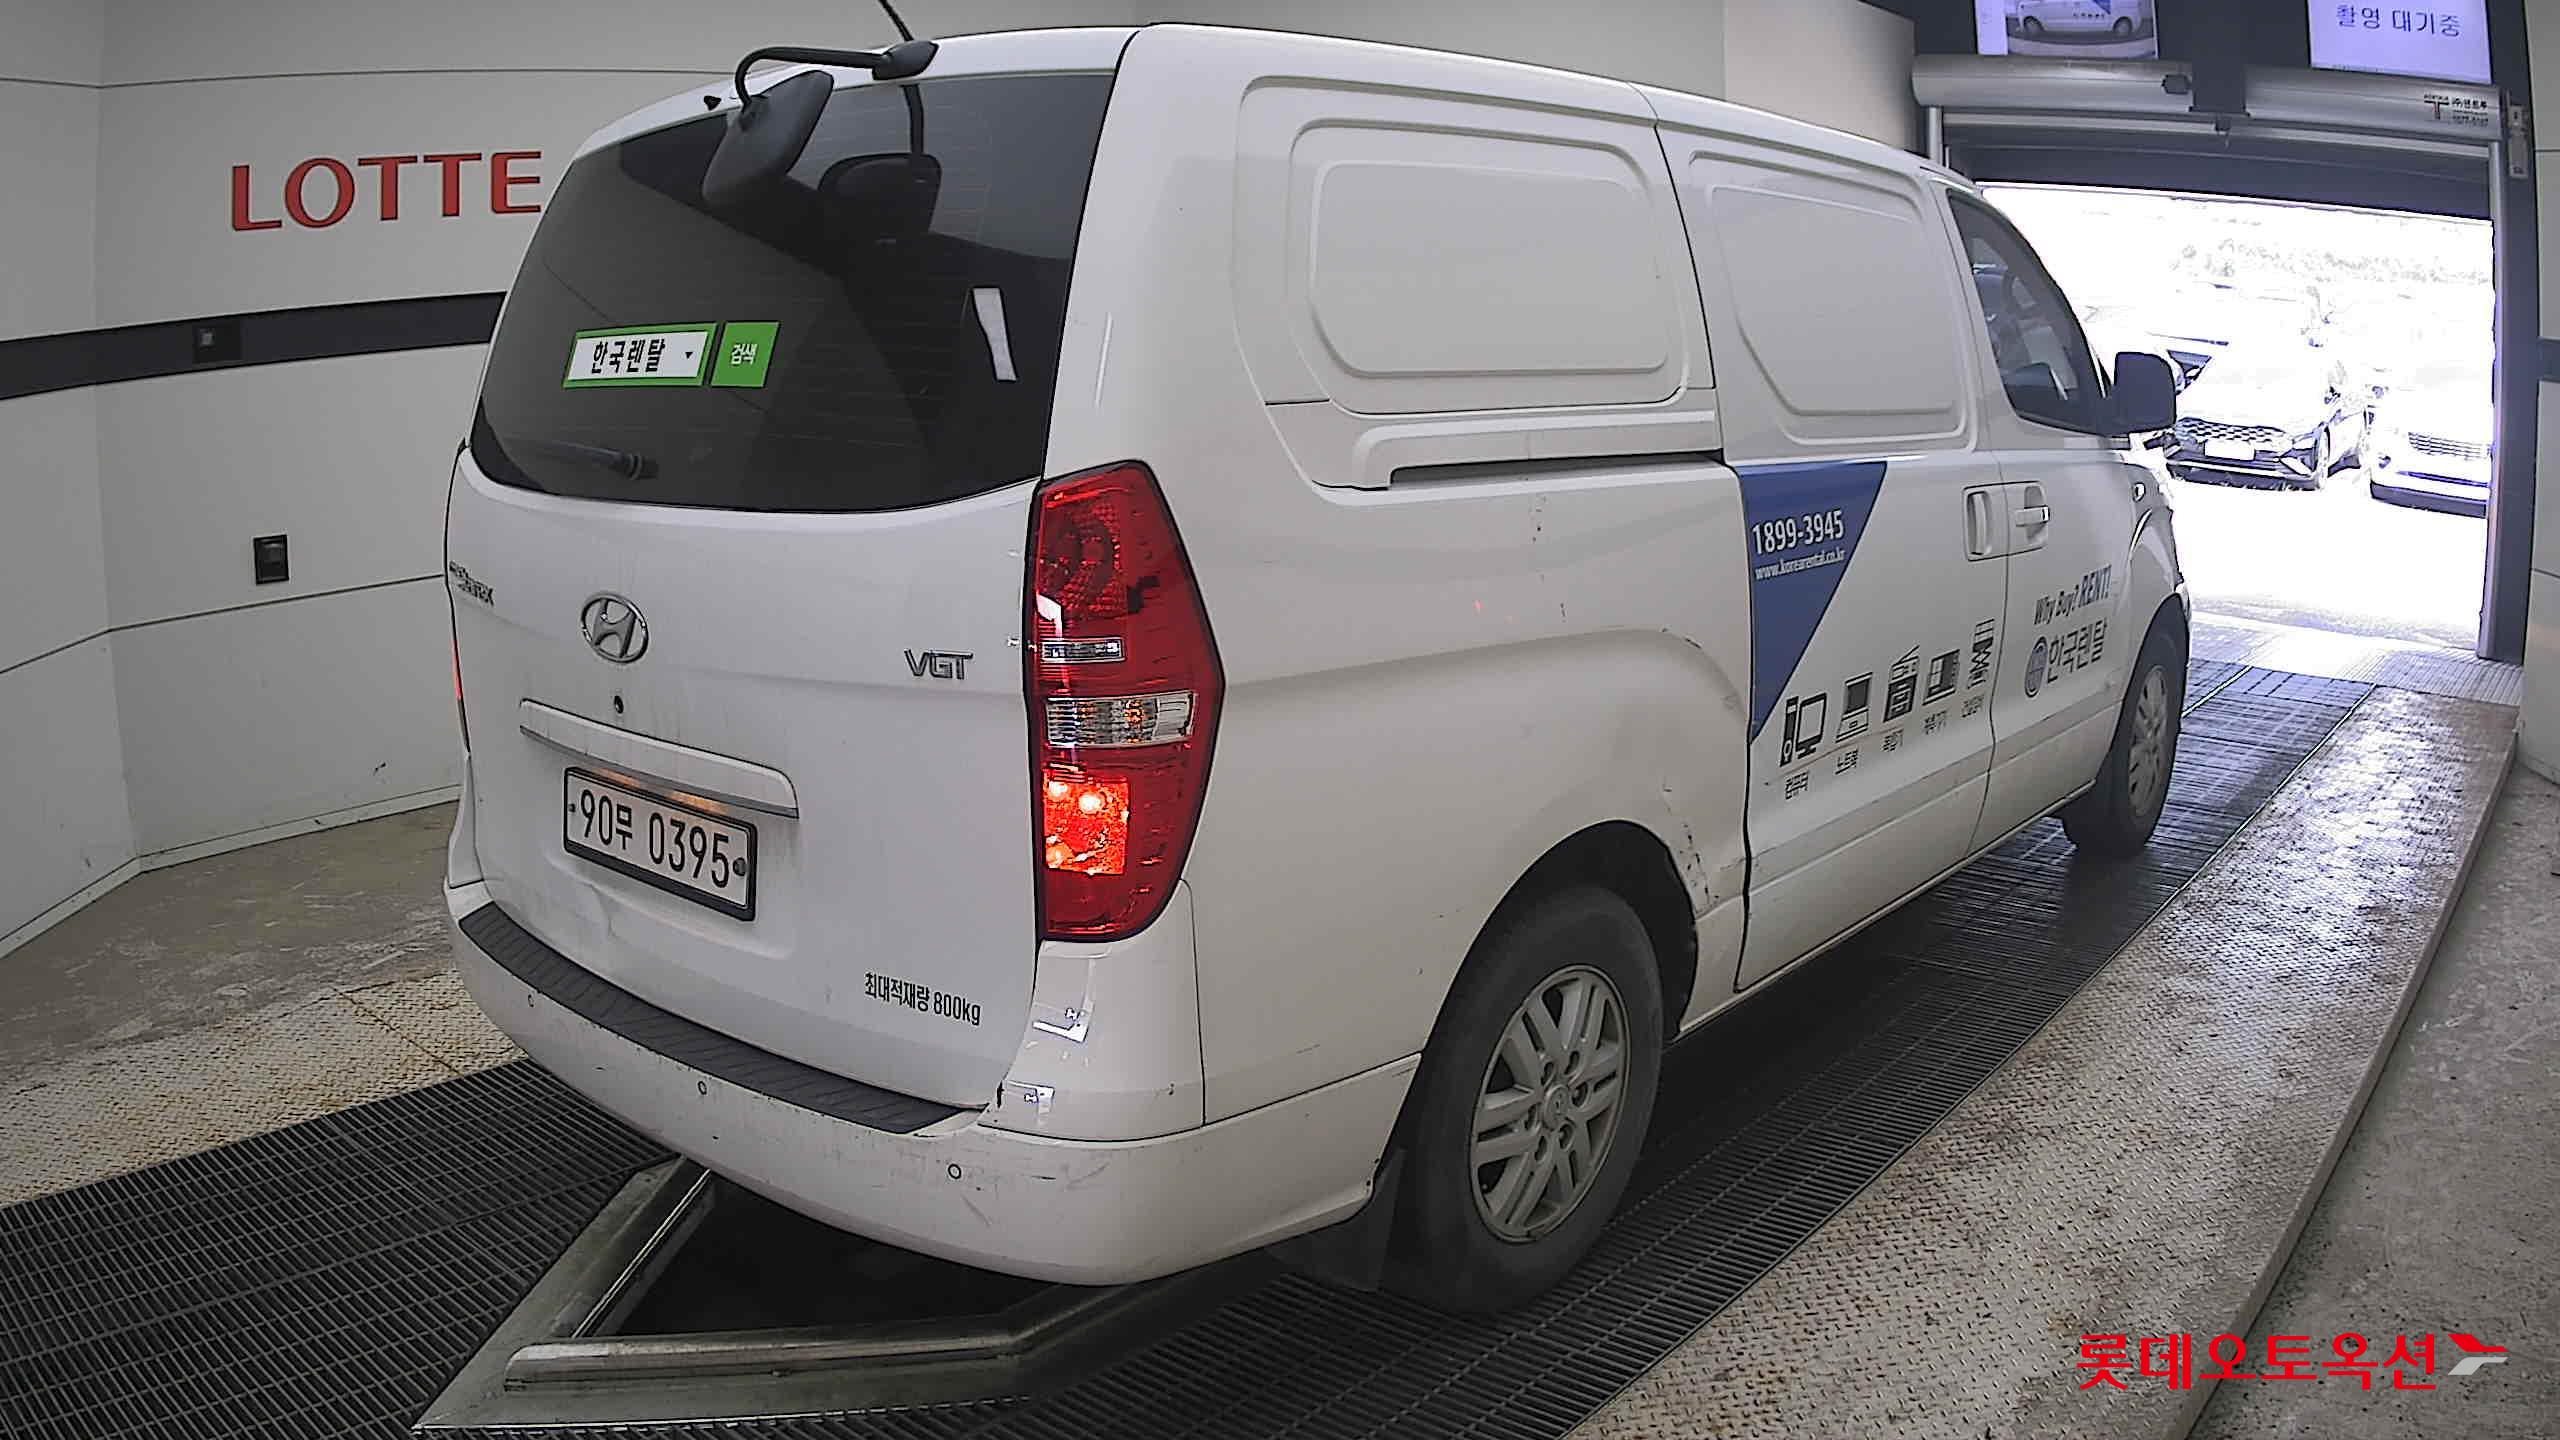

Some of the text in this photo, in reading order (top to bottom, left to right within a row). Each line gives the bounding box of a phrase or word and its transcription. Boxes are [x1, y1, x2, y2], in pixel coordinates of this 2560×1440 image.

[2337, 4, 2460, 38] 촬영 대기중
[231, 151, 542, 231] LOTTE
[591, 338, 756, 374] 한국렌탈 검색
[1752, 509, 1844, 555] 1899-3945
[2033, 595, 2056, 625] Why
[2055, 584, 2079, 617] Buy?
[903, 648, 974, 680] VGT
[2046, 617, 2108, 684] 한국렌탈
[580, 788, 730, 888] 90무 0395
[864, 972, 981, 1026] 최대적재량 800kg
